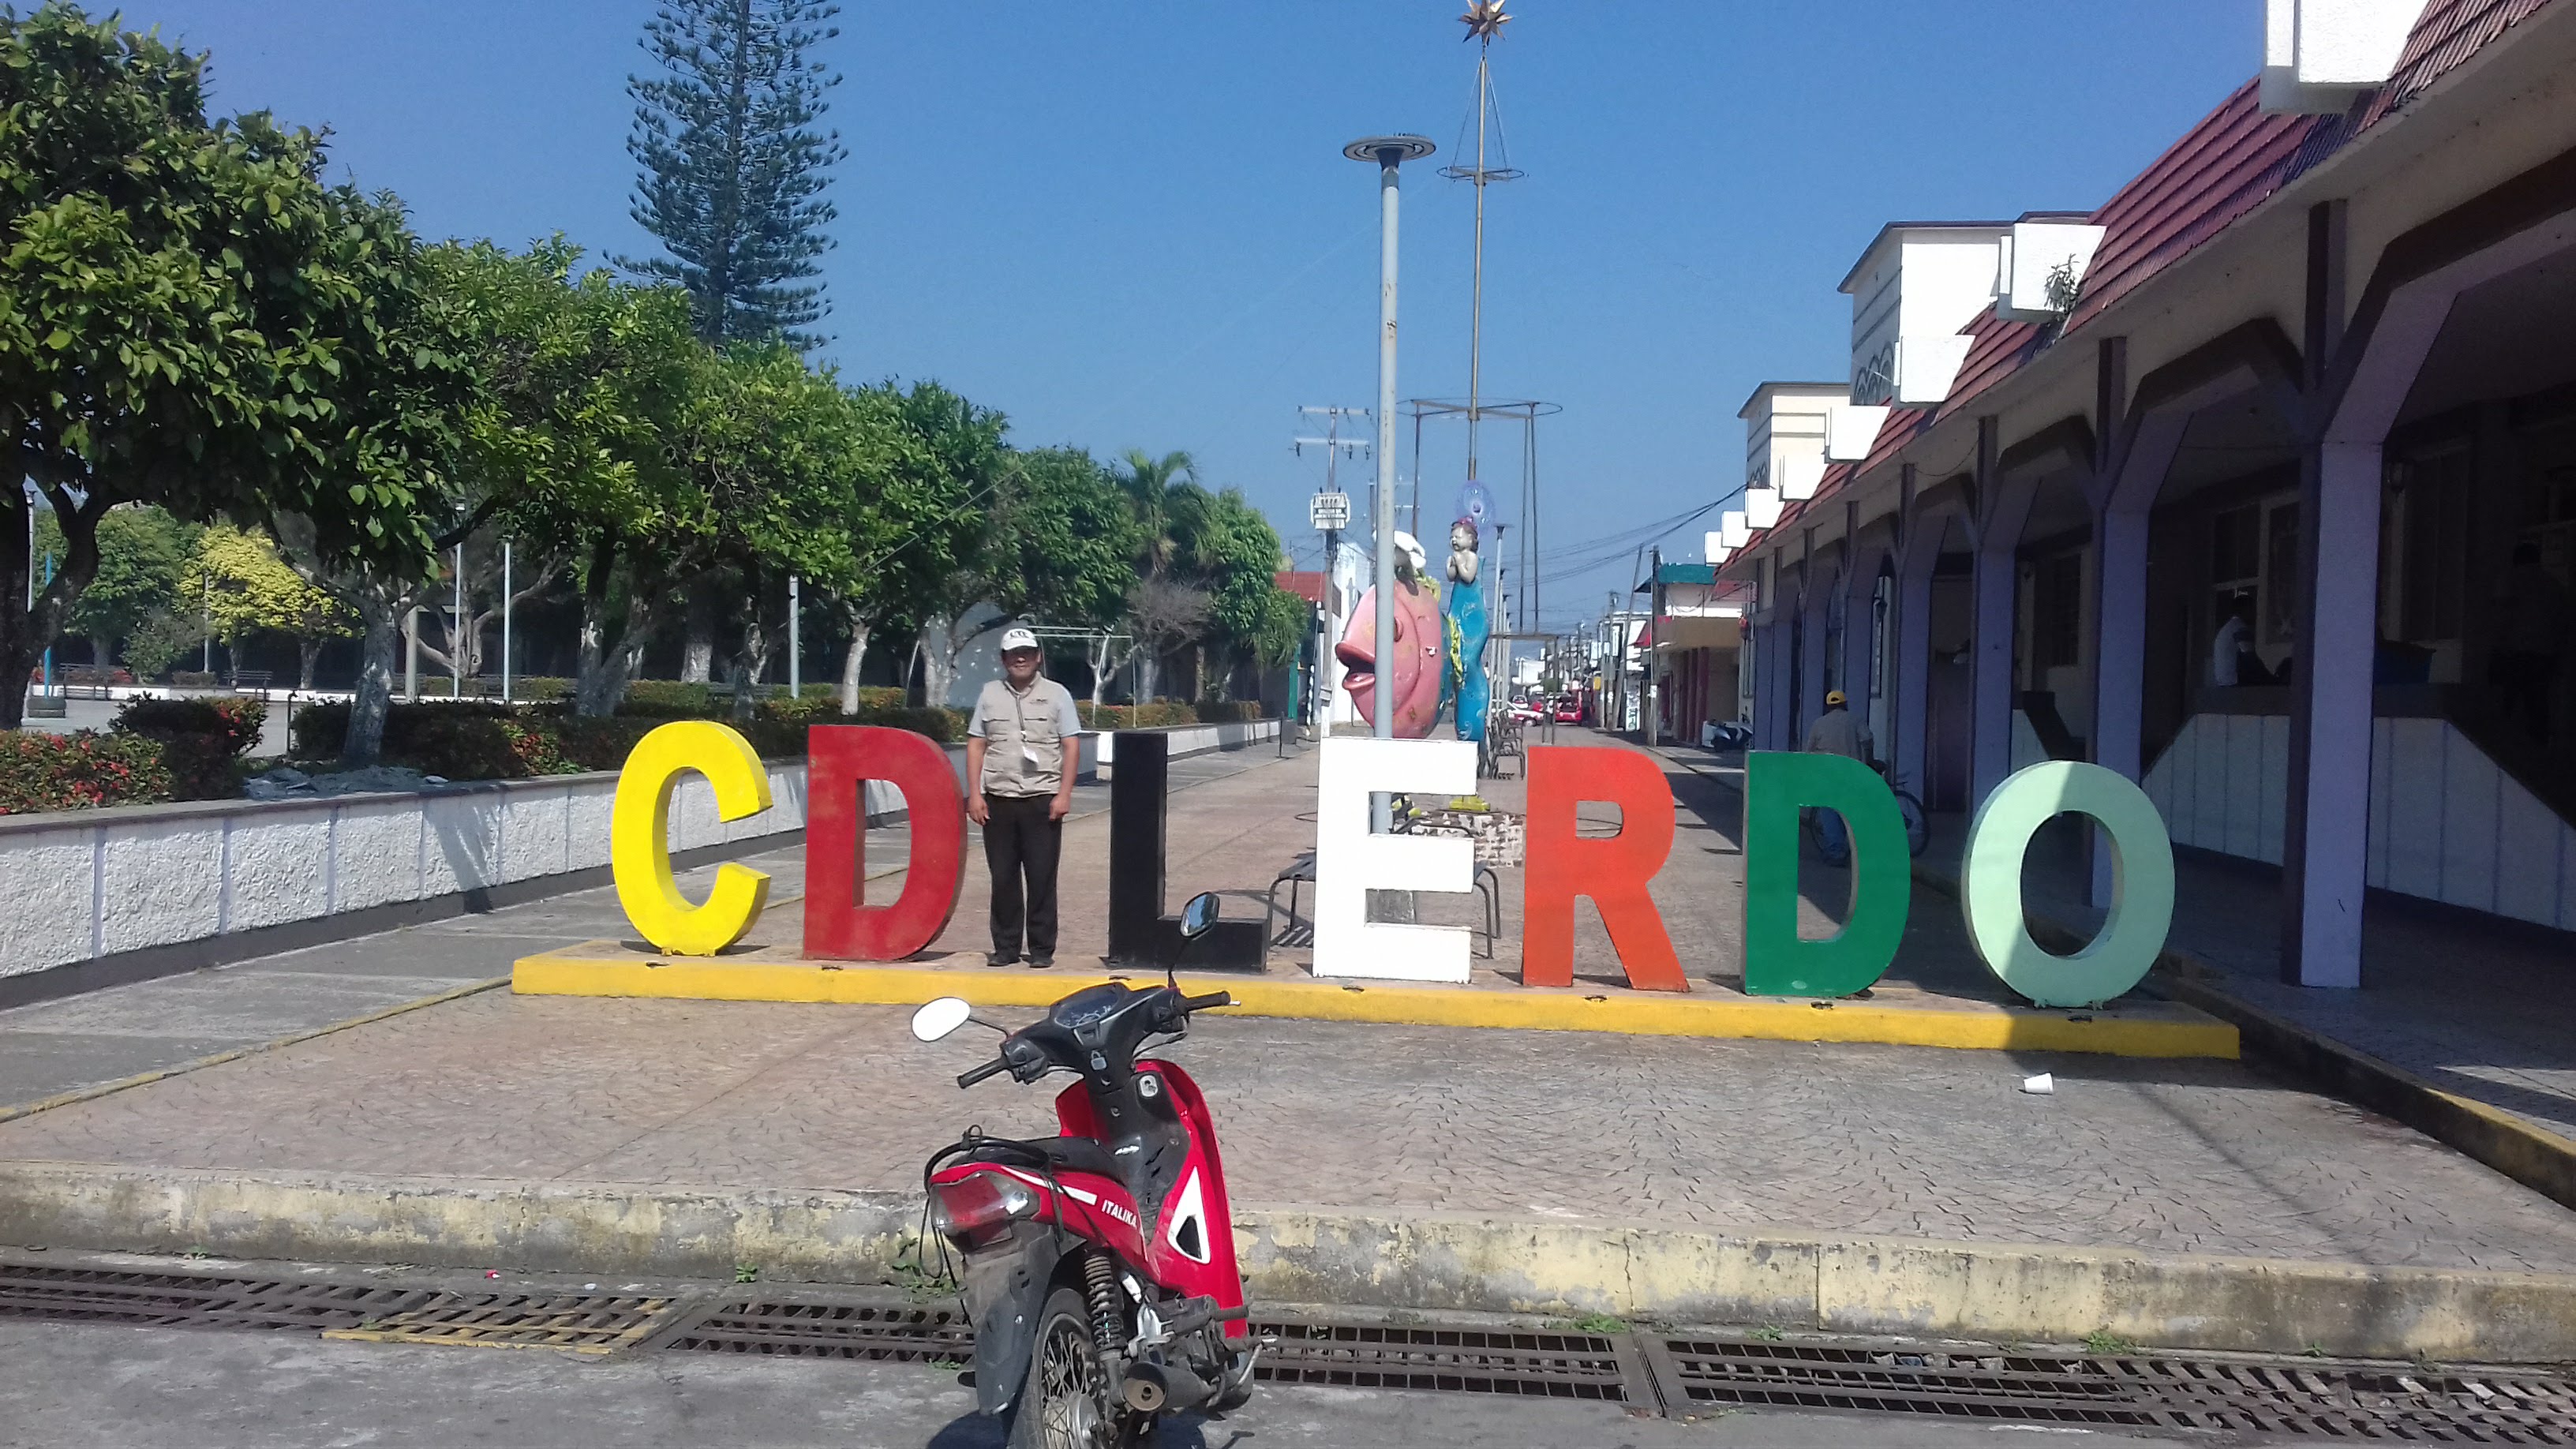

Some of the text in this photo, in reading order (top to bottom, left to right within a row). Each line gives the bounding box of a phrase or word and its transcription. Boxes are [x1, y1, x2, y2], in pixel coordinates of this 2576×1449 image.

[611, 720, 2175, 1009] CD LERDO
[1101, 1199, 1137, 1230] ITALIKA
